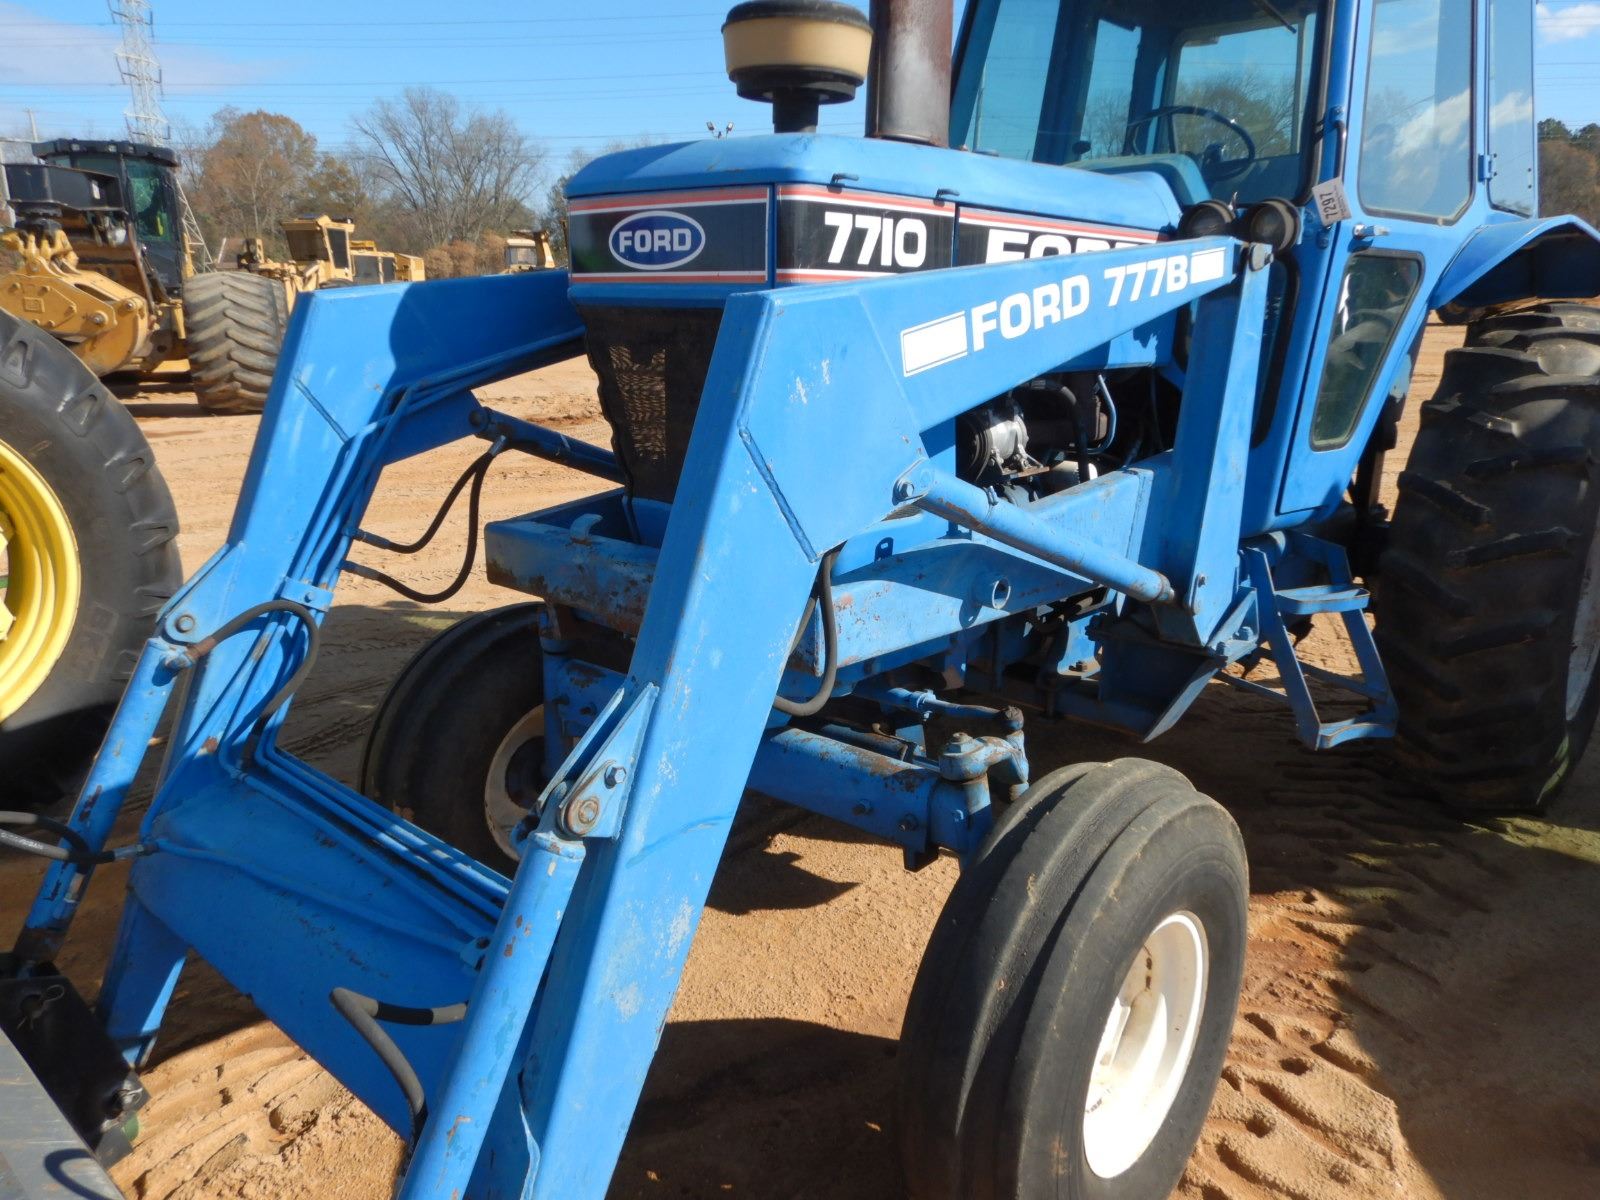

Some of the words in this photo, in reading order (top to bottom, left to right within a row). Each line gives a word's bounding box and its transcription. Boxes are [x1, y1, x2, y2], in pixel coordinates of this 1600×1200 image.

[619, 228, 692, 253] FORD
[824, 211, 927, 268] 7710
[985, 228, 1141, 264] FO
[971, 274, 1090, 352] FORD
[1103, 254, 1188, 308] 777B
